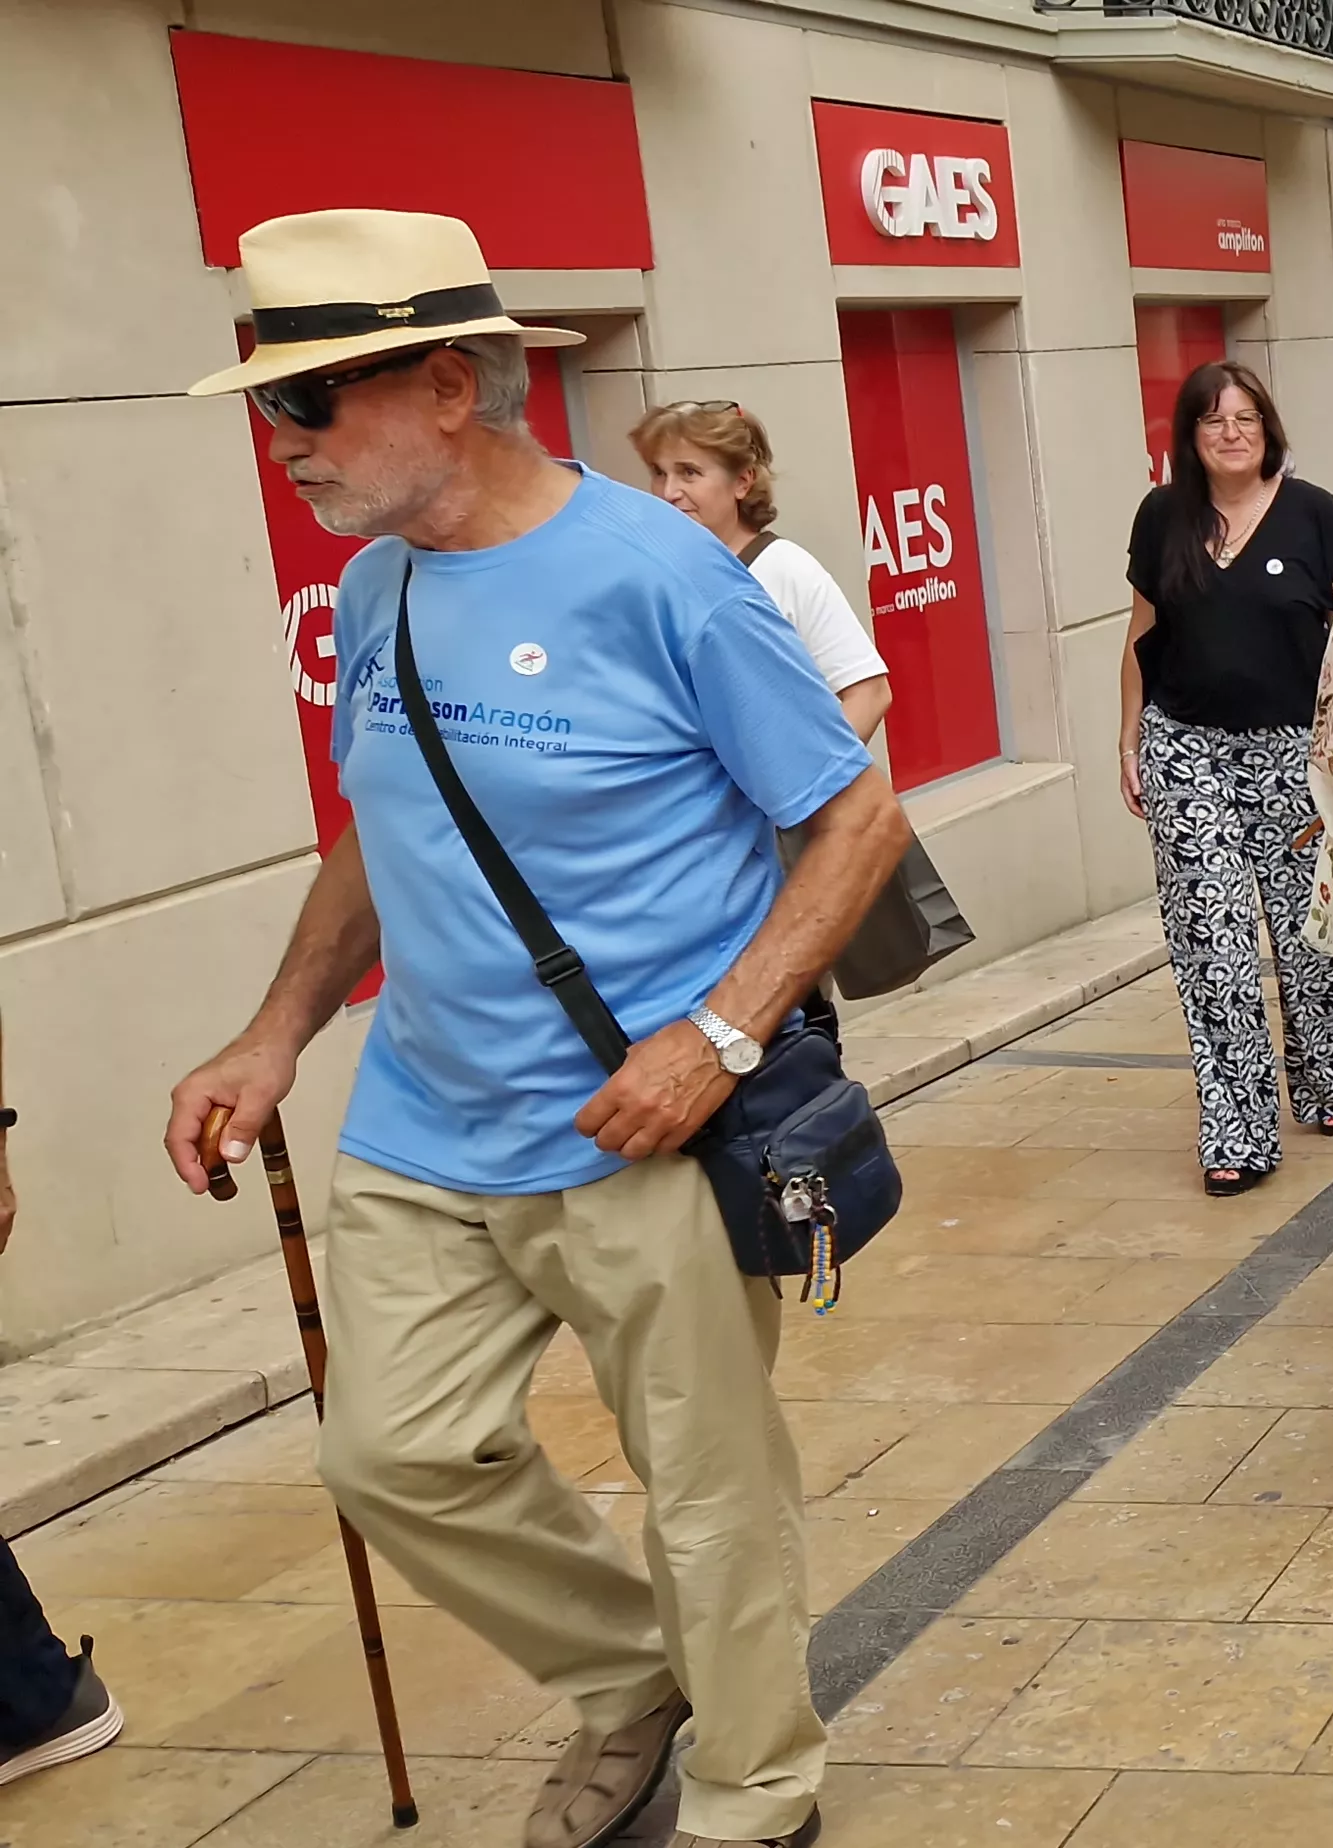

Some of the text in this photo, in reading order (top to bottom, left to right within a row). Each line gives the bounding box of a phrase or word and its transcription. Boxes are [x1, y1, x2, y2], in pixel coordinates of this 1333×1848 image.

[861, 148, 998, 241] GAES
[1218, 227, 1265, 257] amplifon
[894, 575, 958, 613] amplifon
[365, 719, 396, 735] Centro
[504, 734, 569, 753] Integral
